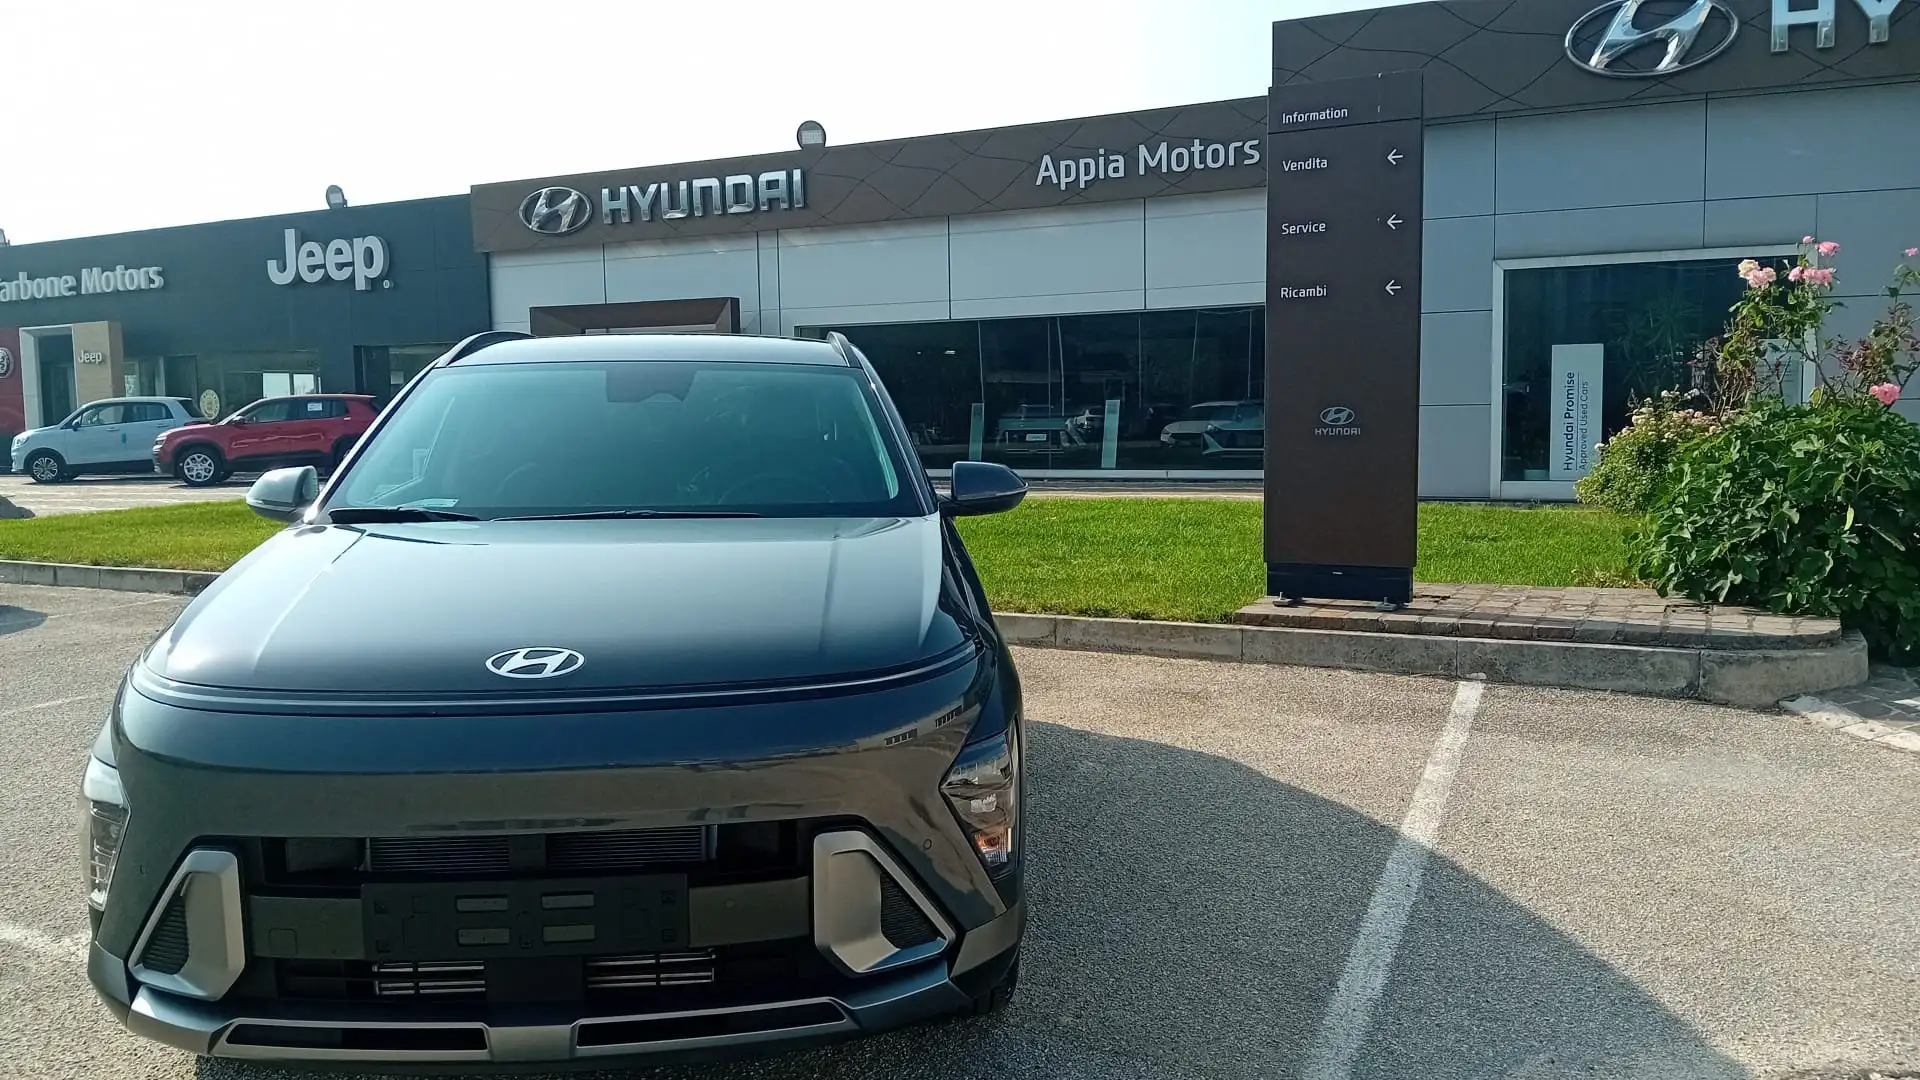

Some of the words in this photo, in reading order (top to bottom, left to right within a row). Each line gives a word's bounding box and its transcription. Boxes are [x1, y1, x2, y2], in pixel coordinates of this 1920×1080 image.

[1282, 107, 1349, 125] Information
[1035, 148, 1126, 191] Appia
[1138, 138, 1261, 176] Motors
[1282, 157, 1329, 172] Vendita
[602, 169, 804, 224] HYUNDAI
[1281, 221, 1327, 236] Service
[267, 229, 390, 291] Jeep
[0, 271, 77, 302] arbone
[81, 264, 164, 295] Motors
[1280, 285, 1328, 299] Ricambi
[78, 350, 103, 365] Jeep
[1564, 371, 1575, 419] Promise
[1580, 381, 1589, 401] Cars
[1580, 403, 1588, 426] Used
[1315, 427, 1361, 435] HYUNDAI
[1563, 422, 1575, 471] Hyundai
[1579, 428, 1588, 470] Approved
